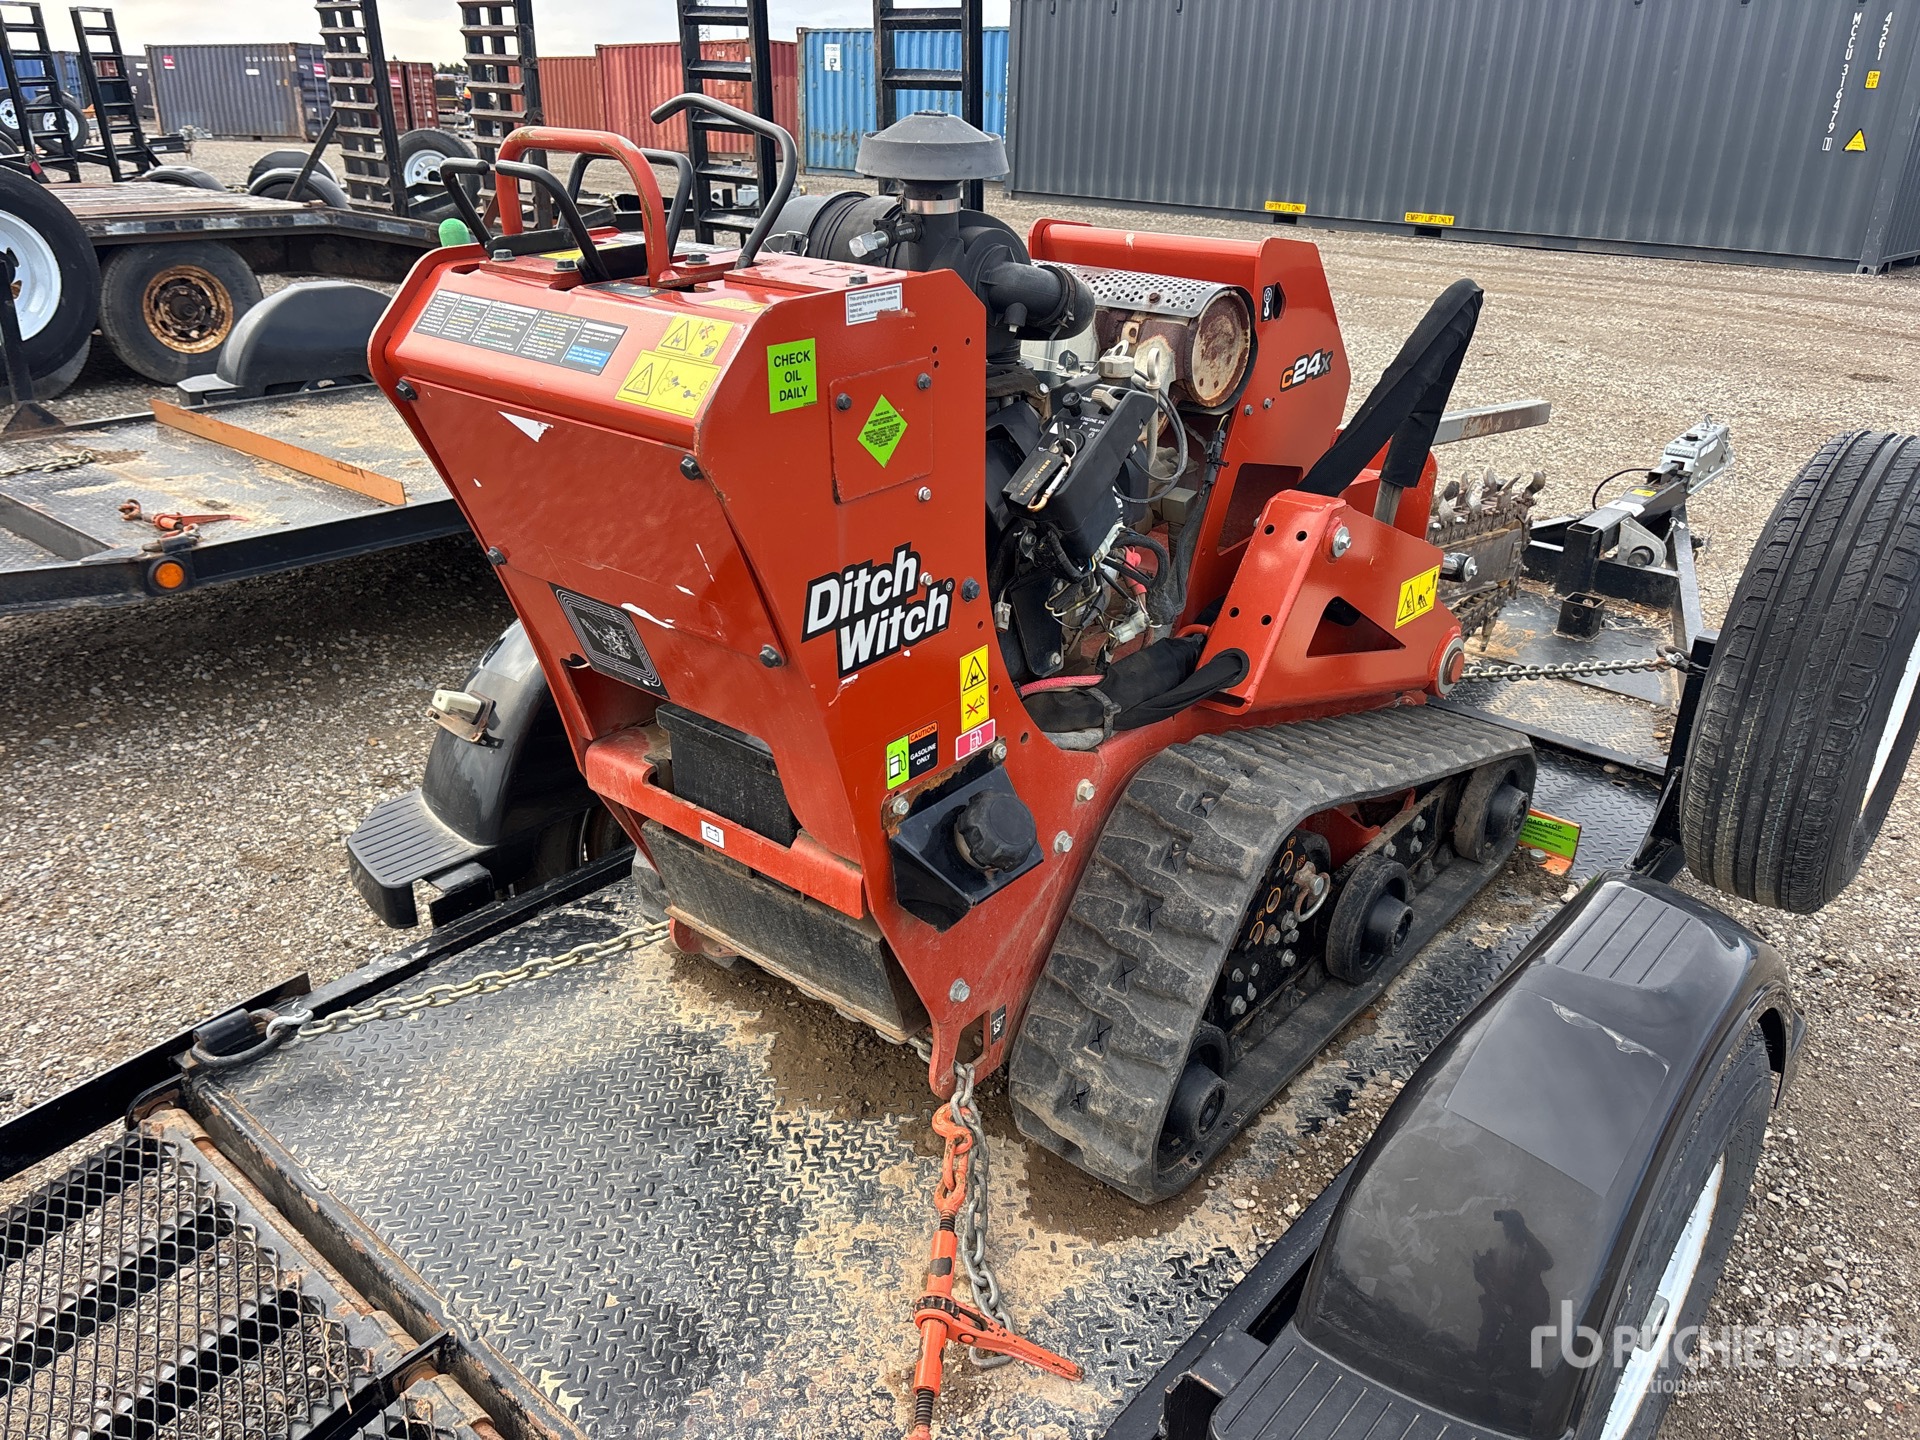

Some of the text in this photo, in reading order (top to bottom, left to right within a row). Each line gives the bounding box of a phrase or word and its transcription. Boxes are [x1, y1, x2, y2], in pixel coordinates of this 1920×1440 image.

[1845, 12, 1862, 61] MCCU
[1877, 12, 1893, 61] 45G1
[1827, 64, 1849, 133] 316479
[1406, 213, 1424, 222] EMPTY
[774, 350, 811, 368] CHECK
[784, 370, 802, 383] OIL
[779, 385, 808, 402] DAILY
[806, 550, 917, 634] Ditch
[840, 585, 949, 672] Witch
[910, 725, 936, 742] CAUTION
[910, 743, 937, 761] GASOLINE
[916, 754, 931, 766] ONLY
[1526, 817, 1563, 831] OAD STOP
